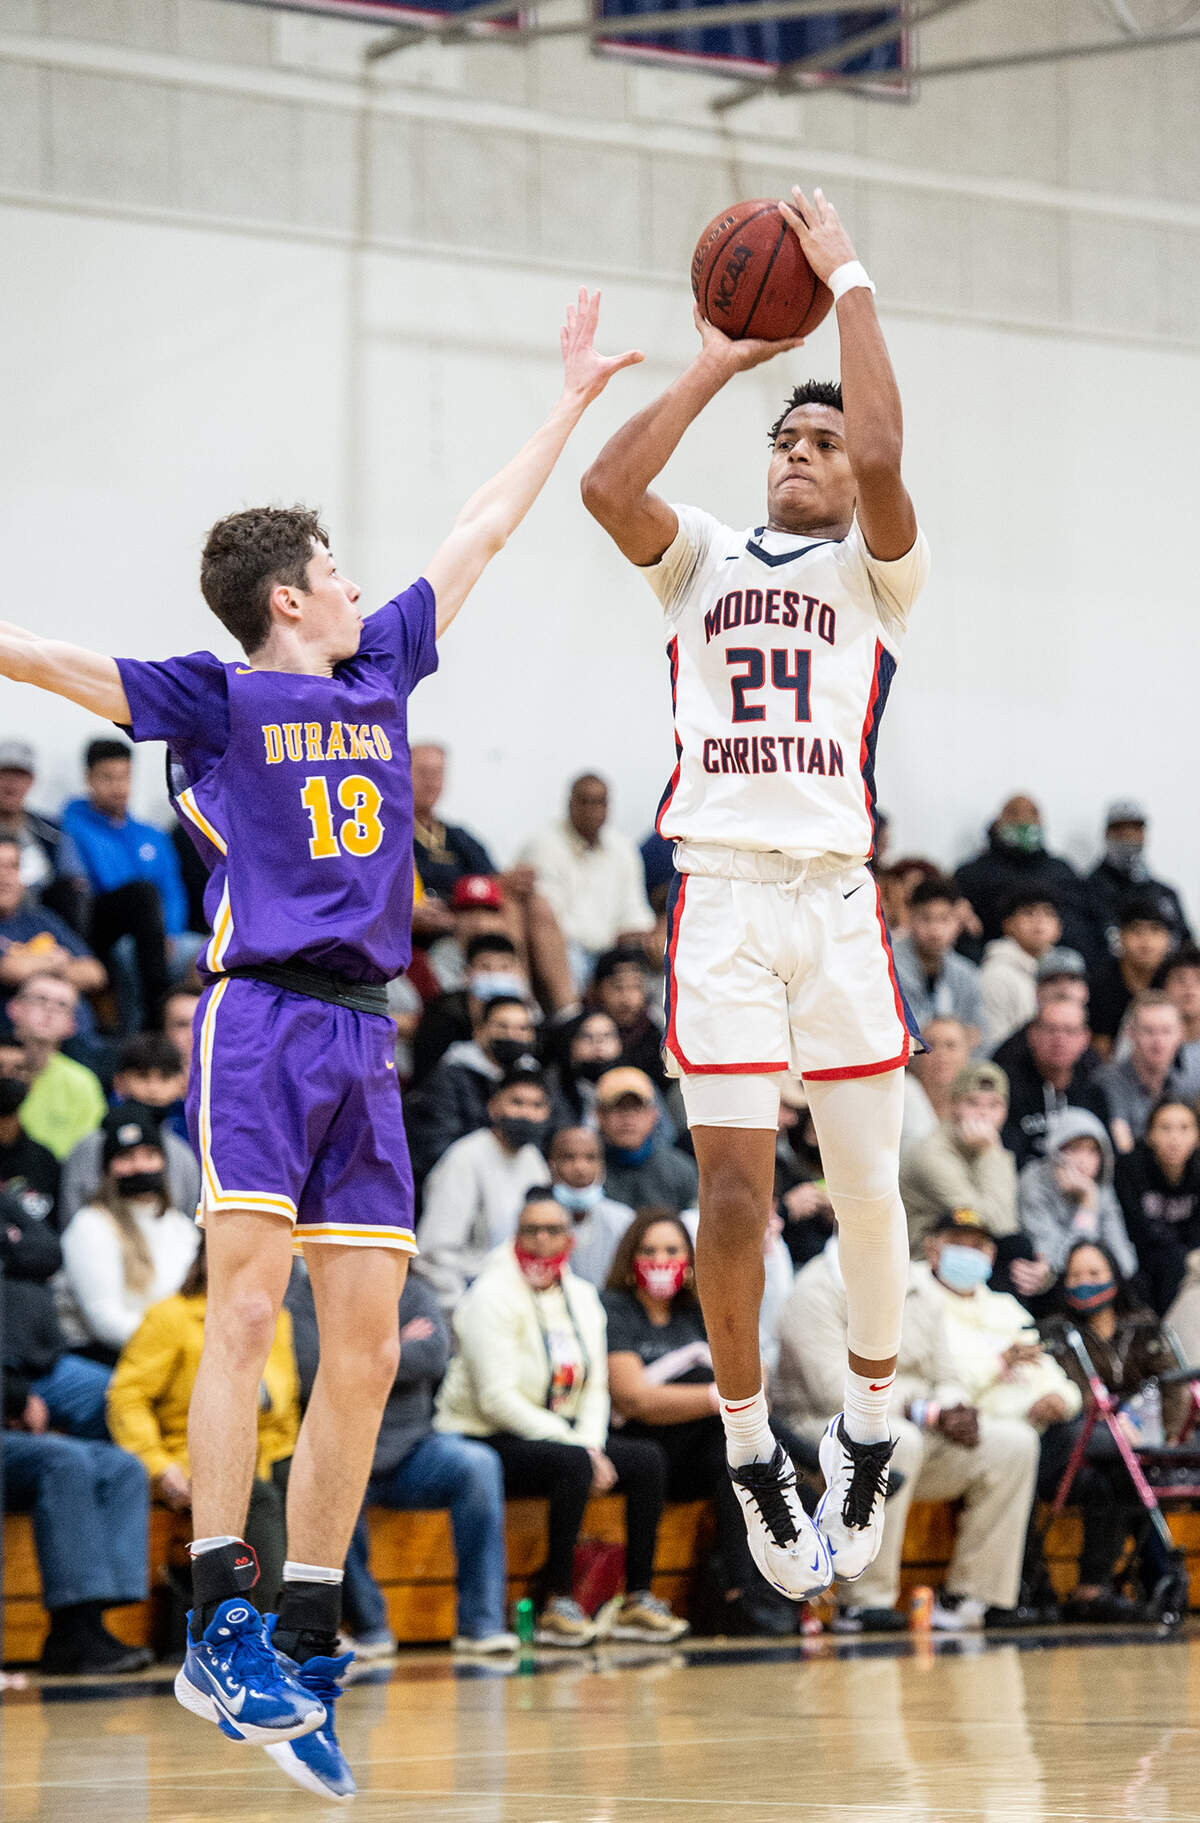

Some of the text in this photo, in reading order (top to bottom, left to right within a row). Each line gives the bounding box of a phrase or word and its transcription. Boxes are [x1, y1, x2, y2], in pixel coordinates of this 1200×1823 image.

[714, 245, 753, 315] NCAA
[704, 588, 836, 646] MODESTO
[725, 647, 813, 724] 24
[262, 721, 393, 765] DURANGO
[702, 736, 845, 777] CHRISTIAN
[300, 774, 386, 860] 13
